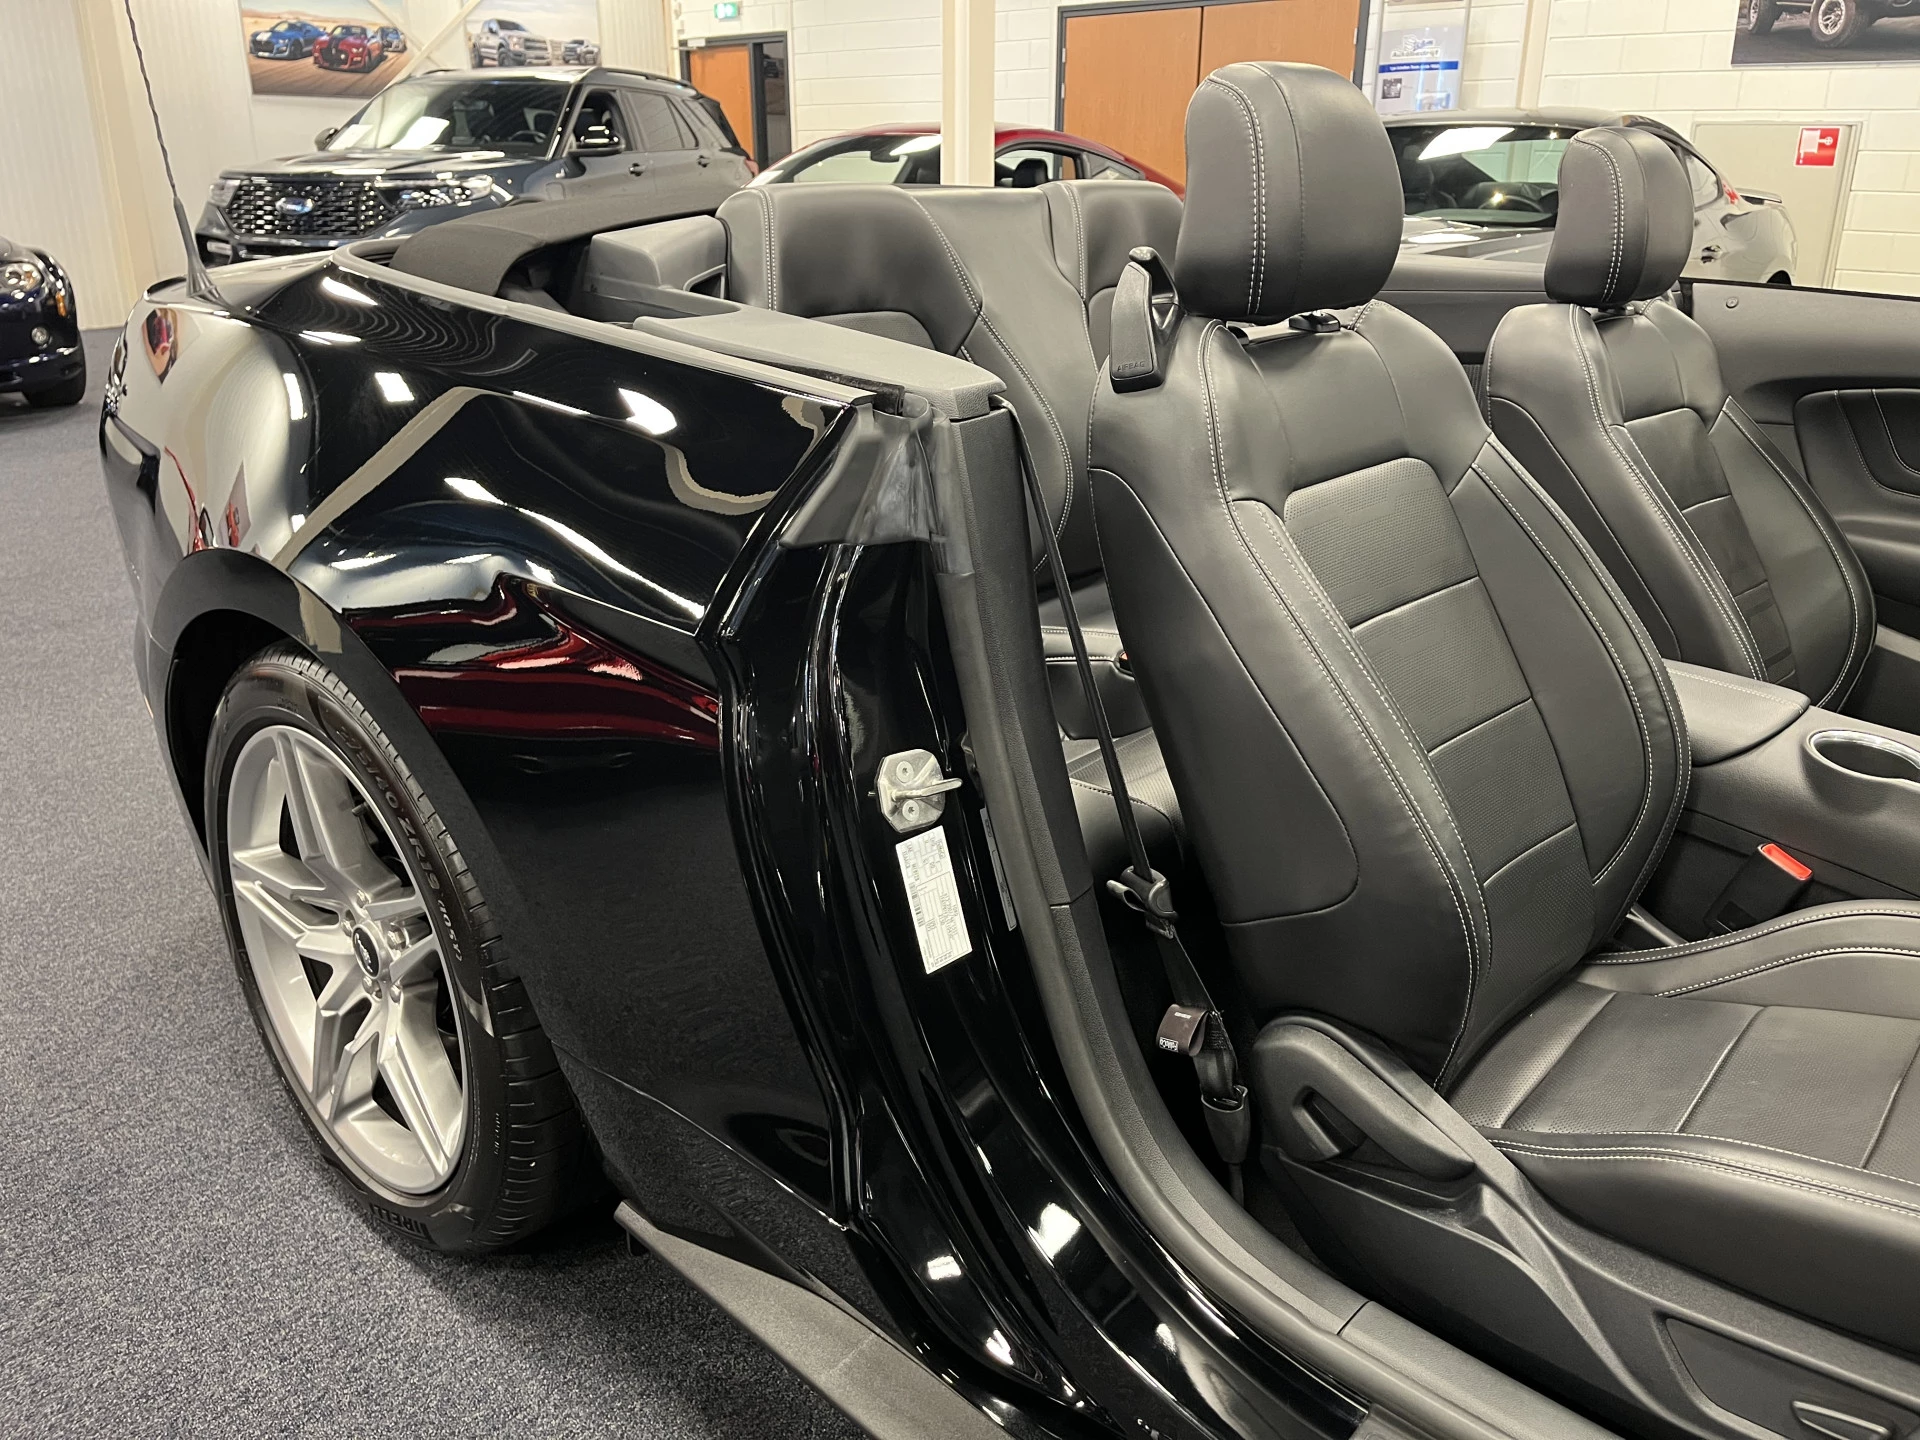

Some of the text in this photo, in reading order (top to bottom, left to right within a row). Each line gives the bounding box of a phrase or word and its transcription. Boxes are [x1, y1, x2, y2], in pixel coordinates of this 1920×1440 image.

[336, 726, 400, 810] 275/40
[397, 815, 440, 890] ZR19
[369, 1203, 437, 1245] PIRELLI
